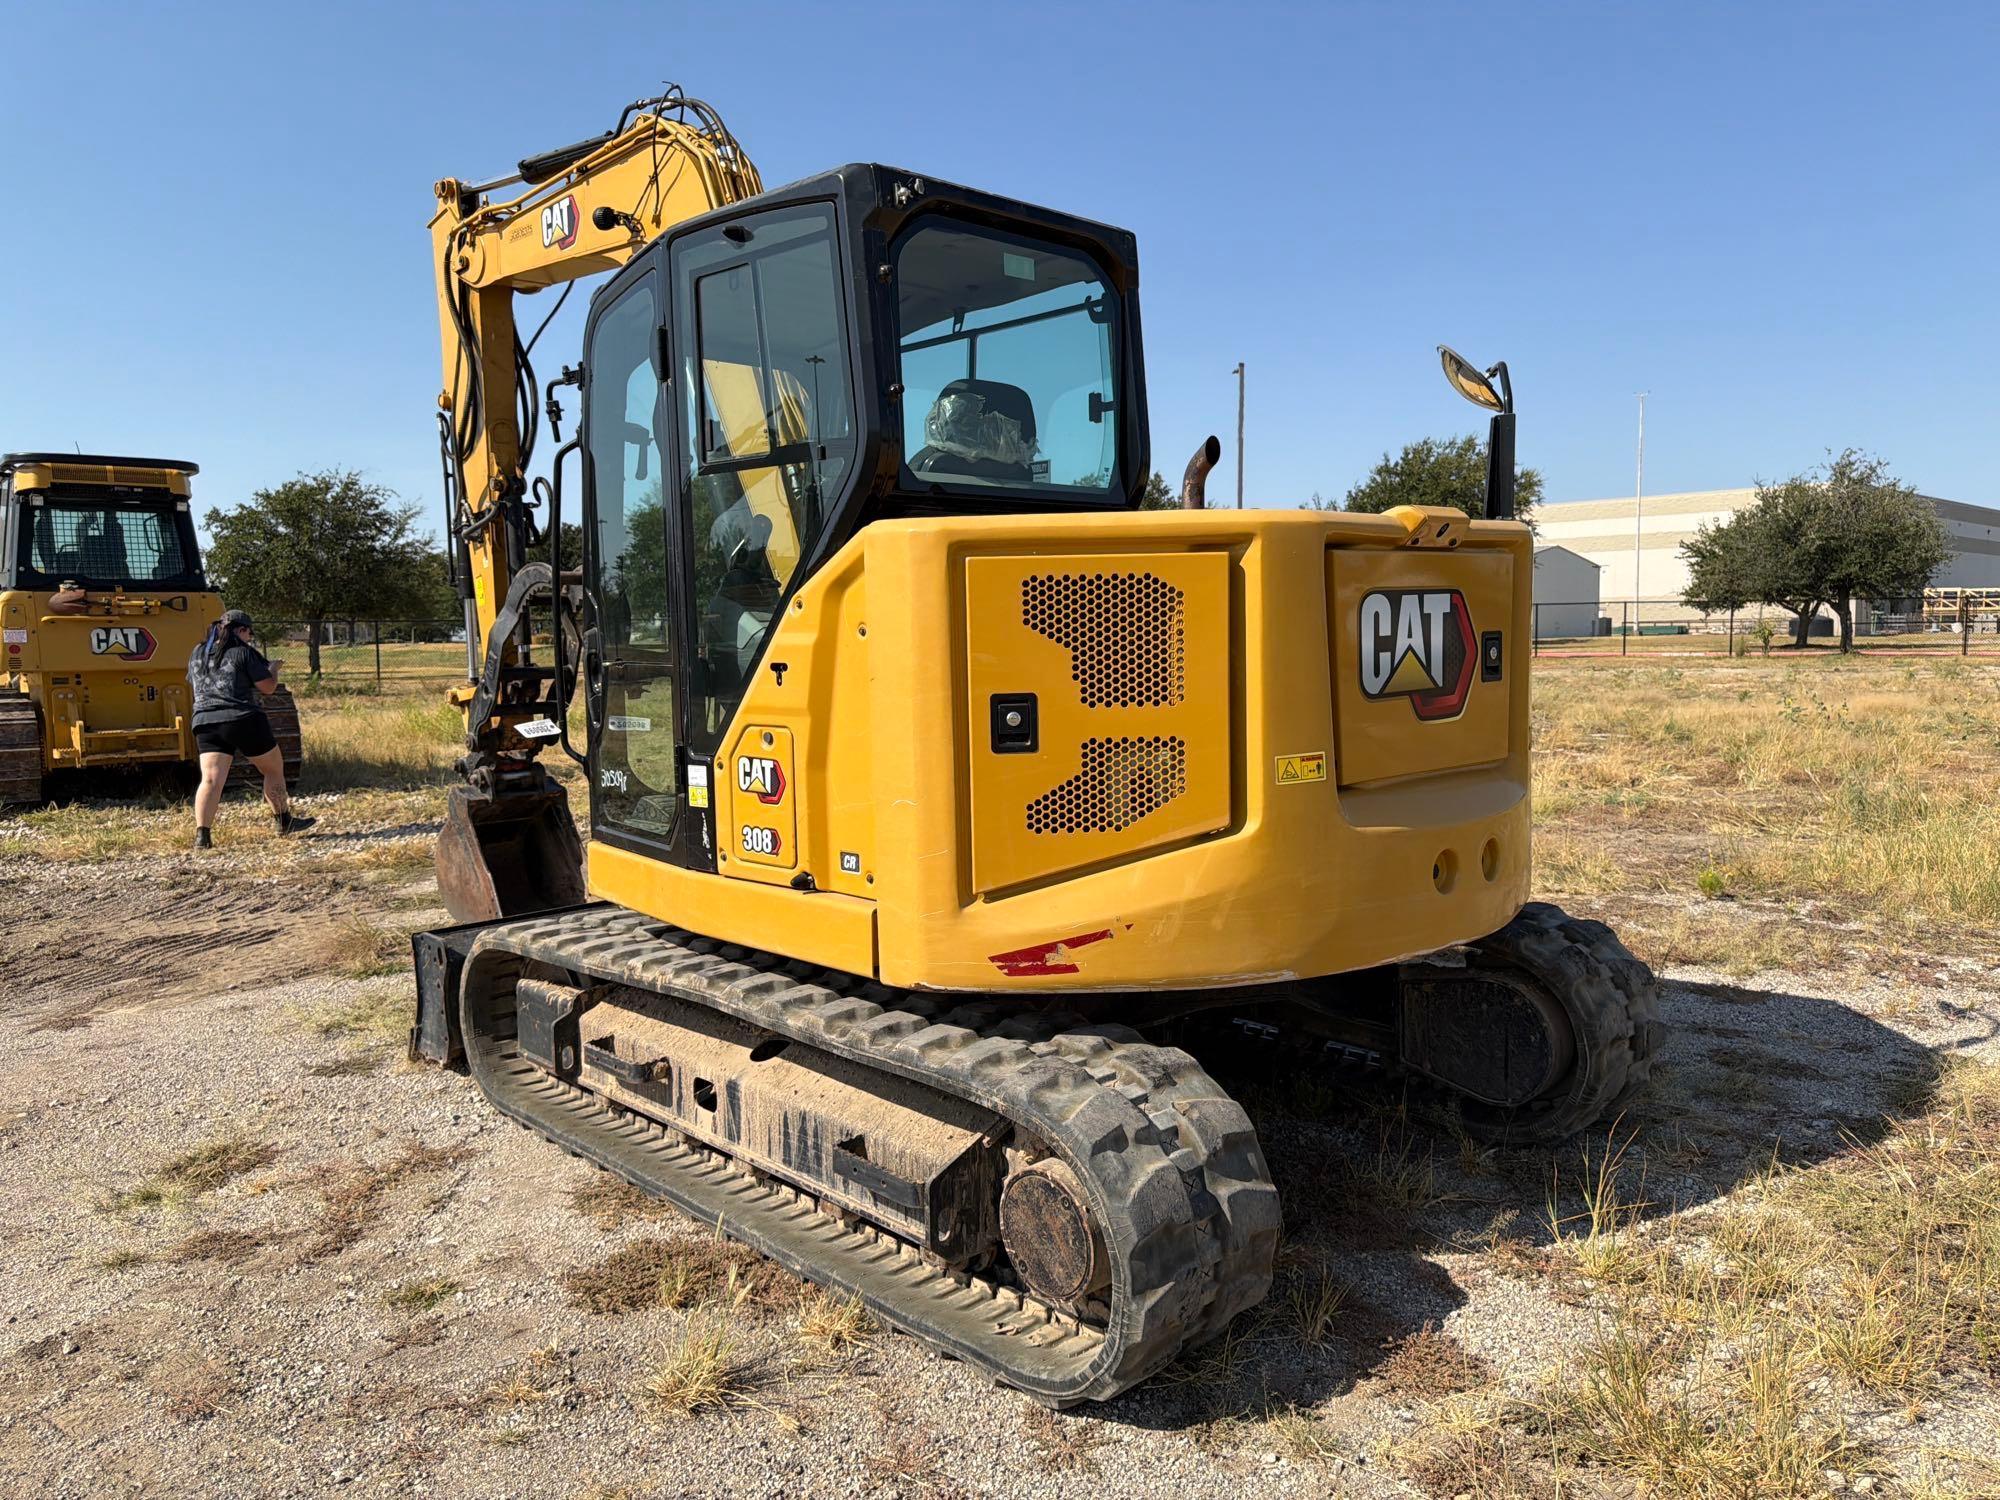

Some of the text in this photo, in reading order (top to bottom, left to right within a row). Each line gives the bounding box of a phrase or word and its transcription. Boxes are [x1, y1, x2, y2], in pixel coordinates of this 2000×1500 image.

[541, 197, 569, 247] CAT
[91, 628, 139, 654] CAT
[1361, 593, 1451, 695] CAT
[738, 756, 774, 794] CAT
[742, 826, 772, 854] 308
[844, 855, 856, 870] CR
